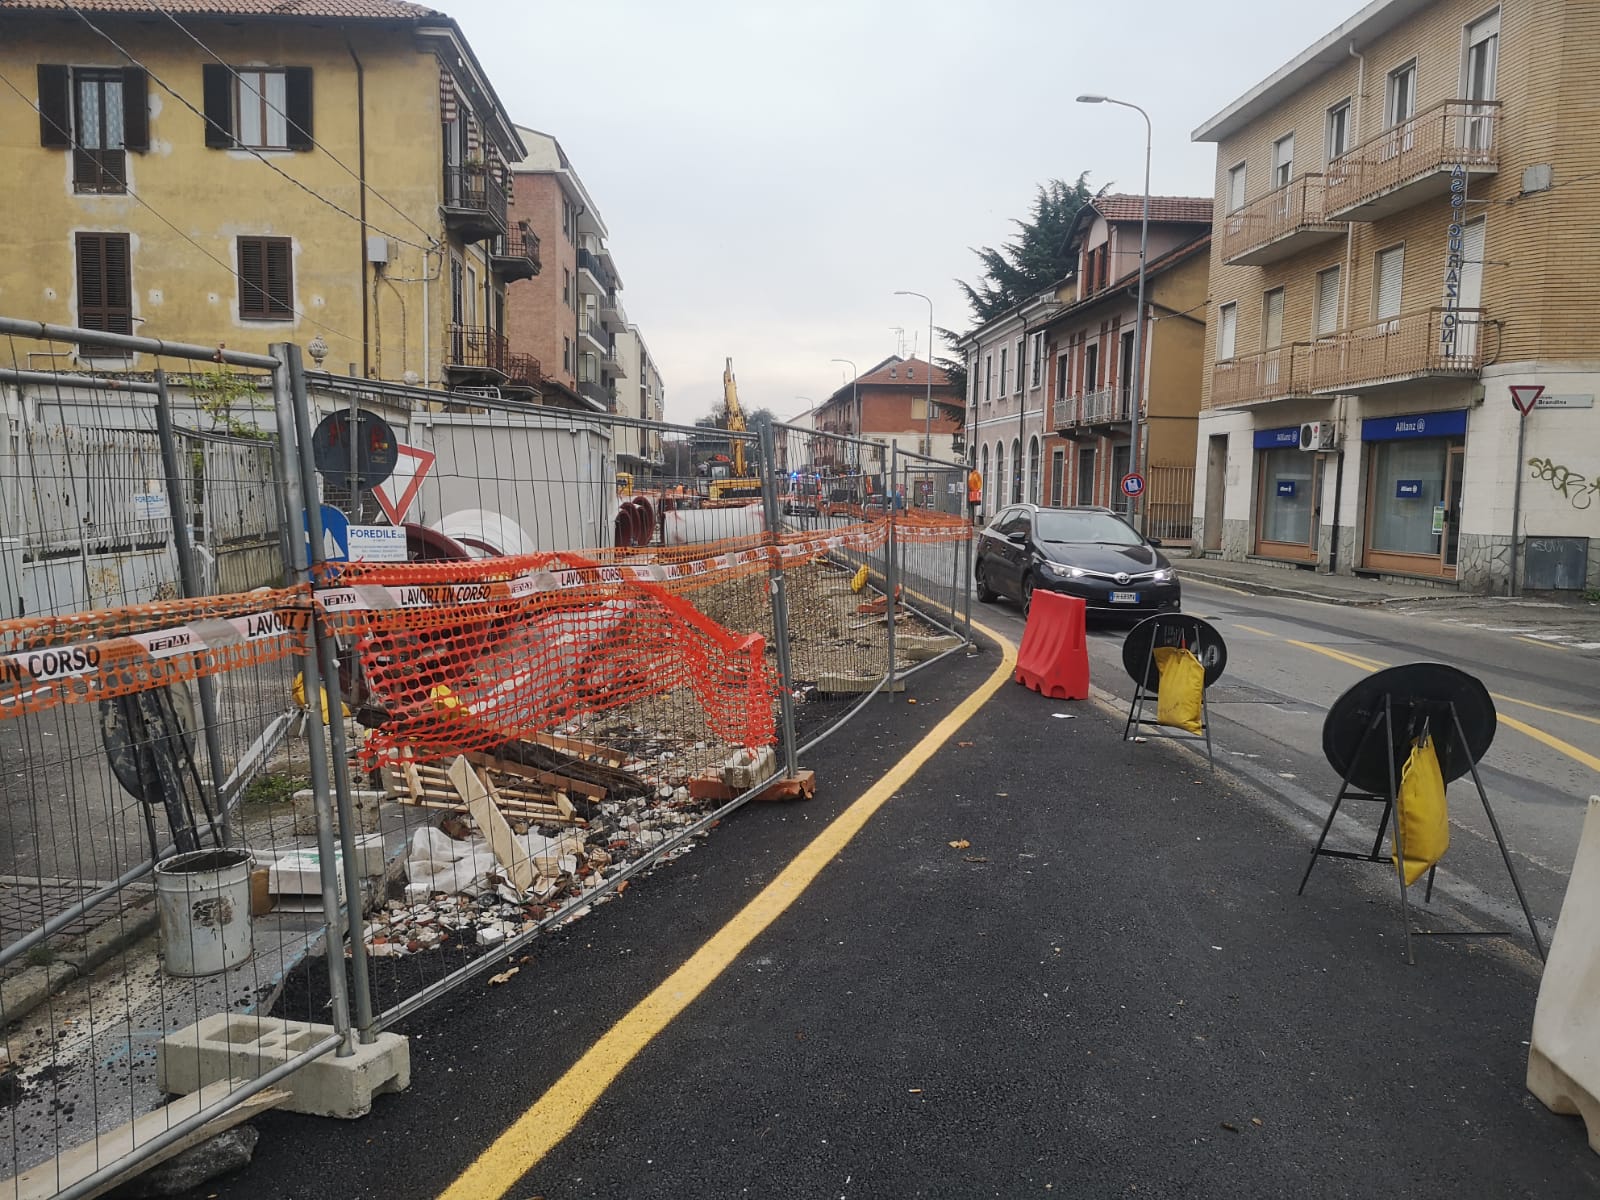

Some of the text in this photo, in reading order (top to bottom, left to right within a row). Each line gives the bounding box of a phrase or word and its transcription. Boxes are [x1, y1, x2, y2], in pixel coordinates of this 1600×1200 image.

[1395, 421, 1416, 432] Allianz
[349, 528, 397, 539] FOREDILE
[560, 568, 590, 586] LAVORI
[590, 568, 600, 583] IN
[600, 567, 624, 582] CORSO
[400, 585, 492, 606] LAVORI IN CORSO
[247, 611, 297, 638] LAVORI
[149, 633, 191, 651] TENAX
[27, 645, 101, 679] CORSO
